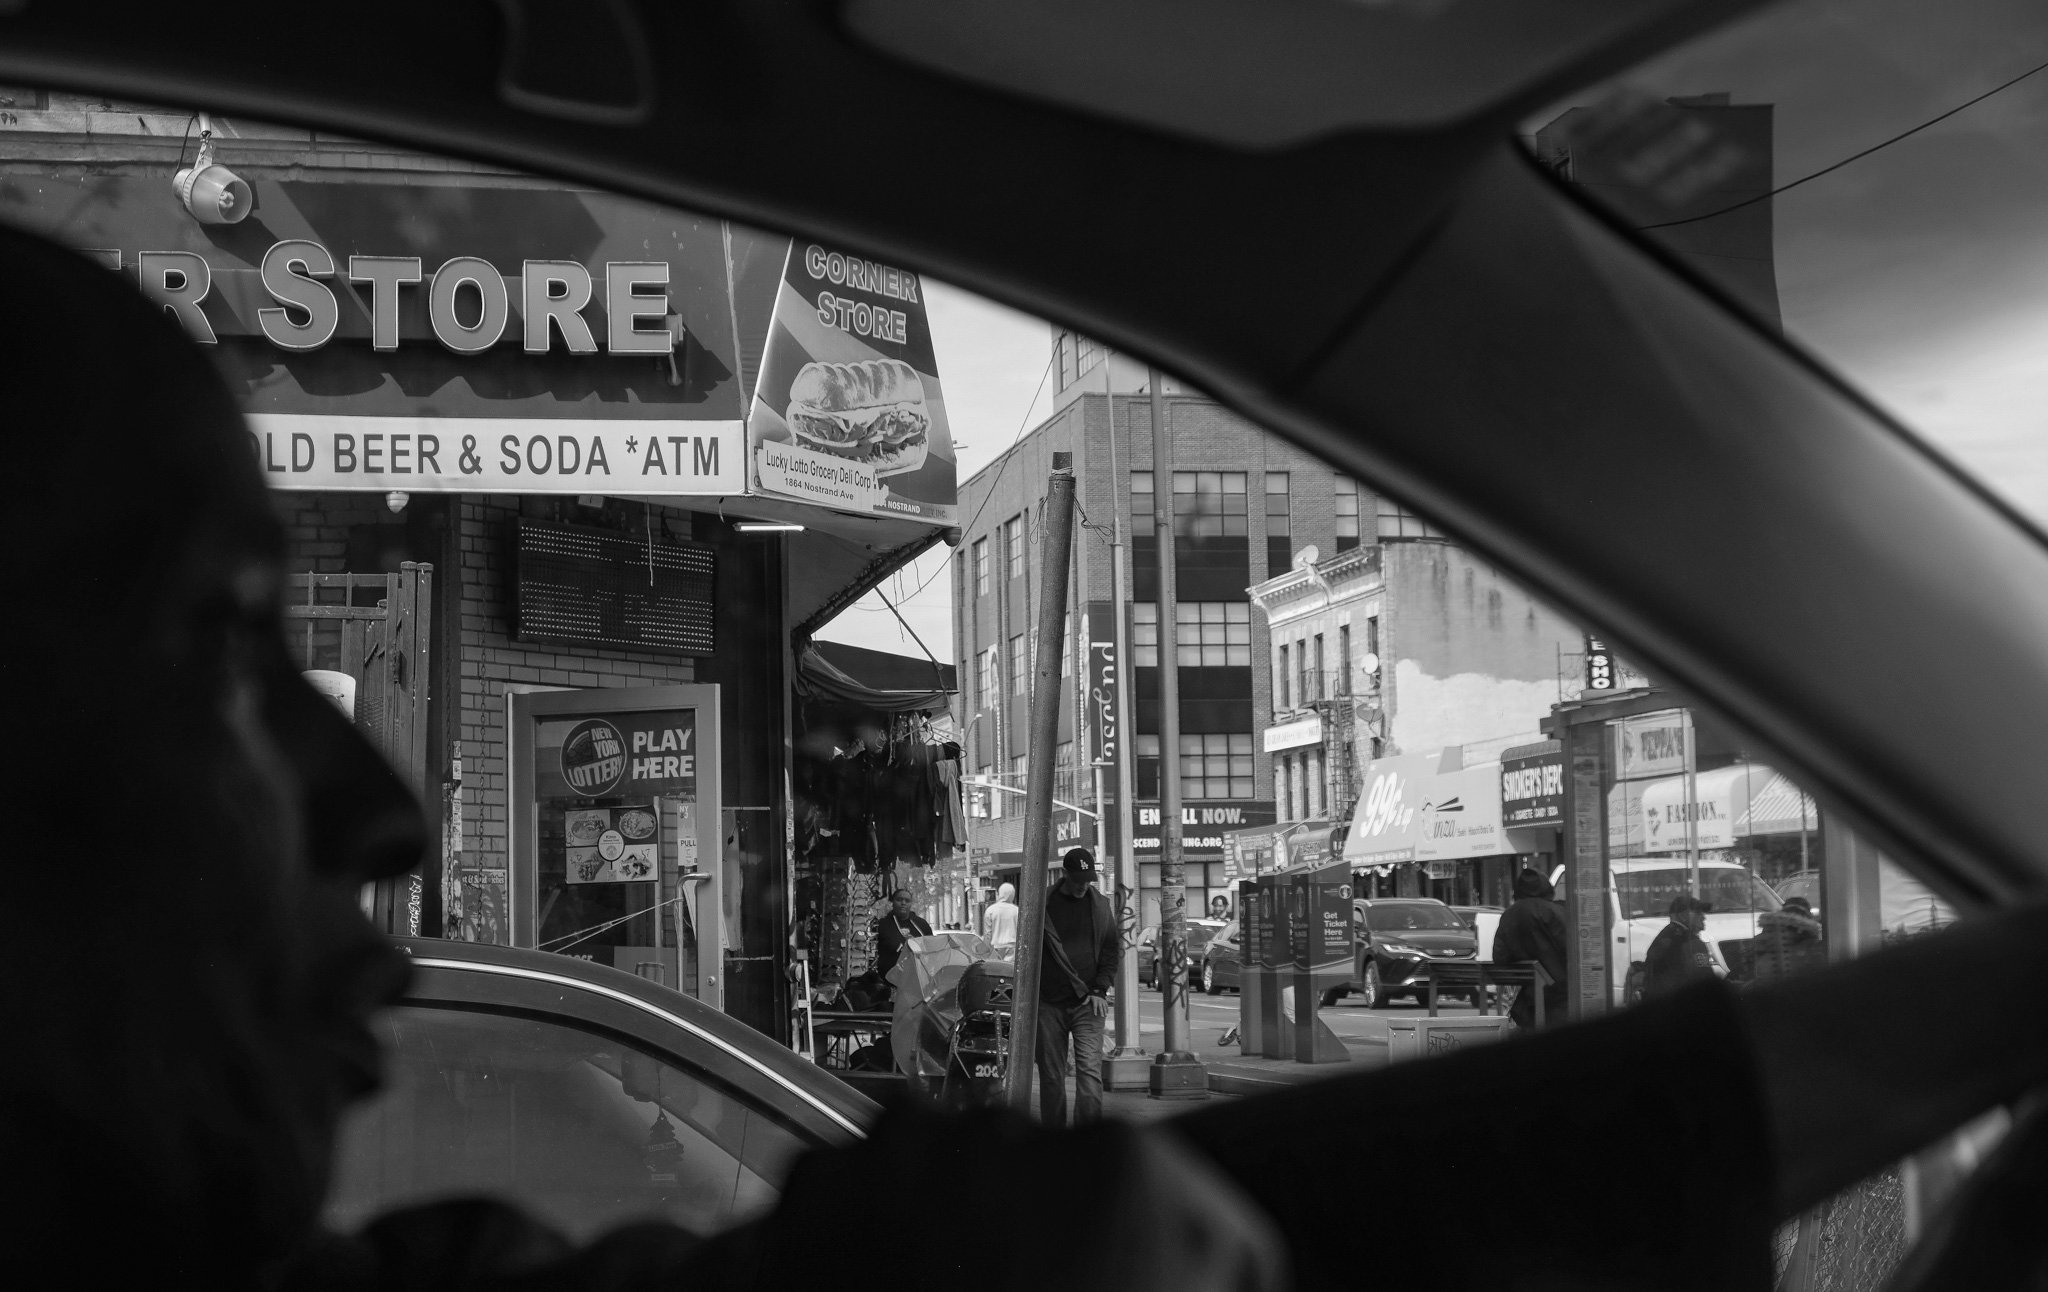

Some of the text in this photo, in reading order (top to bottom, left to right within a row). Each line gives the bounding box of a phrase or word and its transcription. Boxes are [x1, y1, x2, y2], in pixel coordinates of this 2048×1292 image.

[805, 244, 919, 303] CORNER
[258, 239, 673, 355] STORE
[817, 291, 907, 344] STORE
[250, 430, 315, 473] LD
[334, 434, 442, 475] BEER
[458, 436, 483, 475] &
[499, 434, 611, 475] SODA
[766, 449, 788, 474] Lucky
[789, 457, 809, 476] Lotto
[810, 462, 838, 485] Grocery
[839, 467, 853, 485] Deli
[854, 470, 871, 492] Corp
[785, 478, 854, 501] 1864 Nostrand Ave
[887, 500, 921, 514] NOSTRAND
[591, 727, 612, 741] NEW
[633, 728, 692, 753] PLAY
[594, 739, 621, 759] YORK
[567, 757, 623, 787] LOTTERY
[632, 755, 694, 780] HERE
[1139, 807, 1247, 825] ENLL NOW.
[1666, 801, 1718, 824] FASION
[680, 839, 696, 847] PULL
[1324, 911, 1338, 919] Get
[1324, 928, 1343, 936] Here
